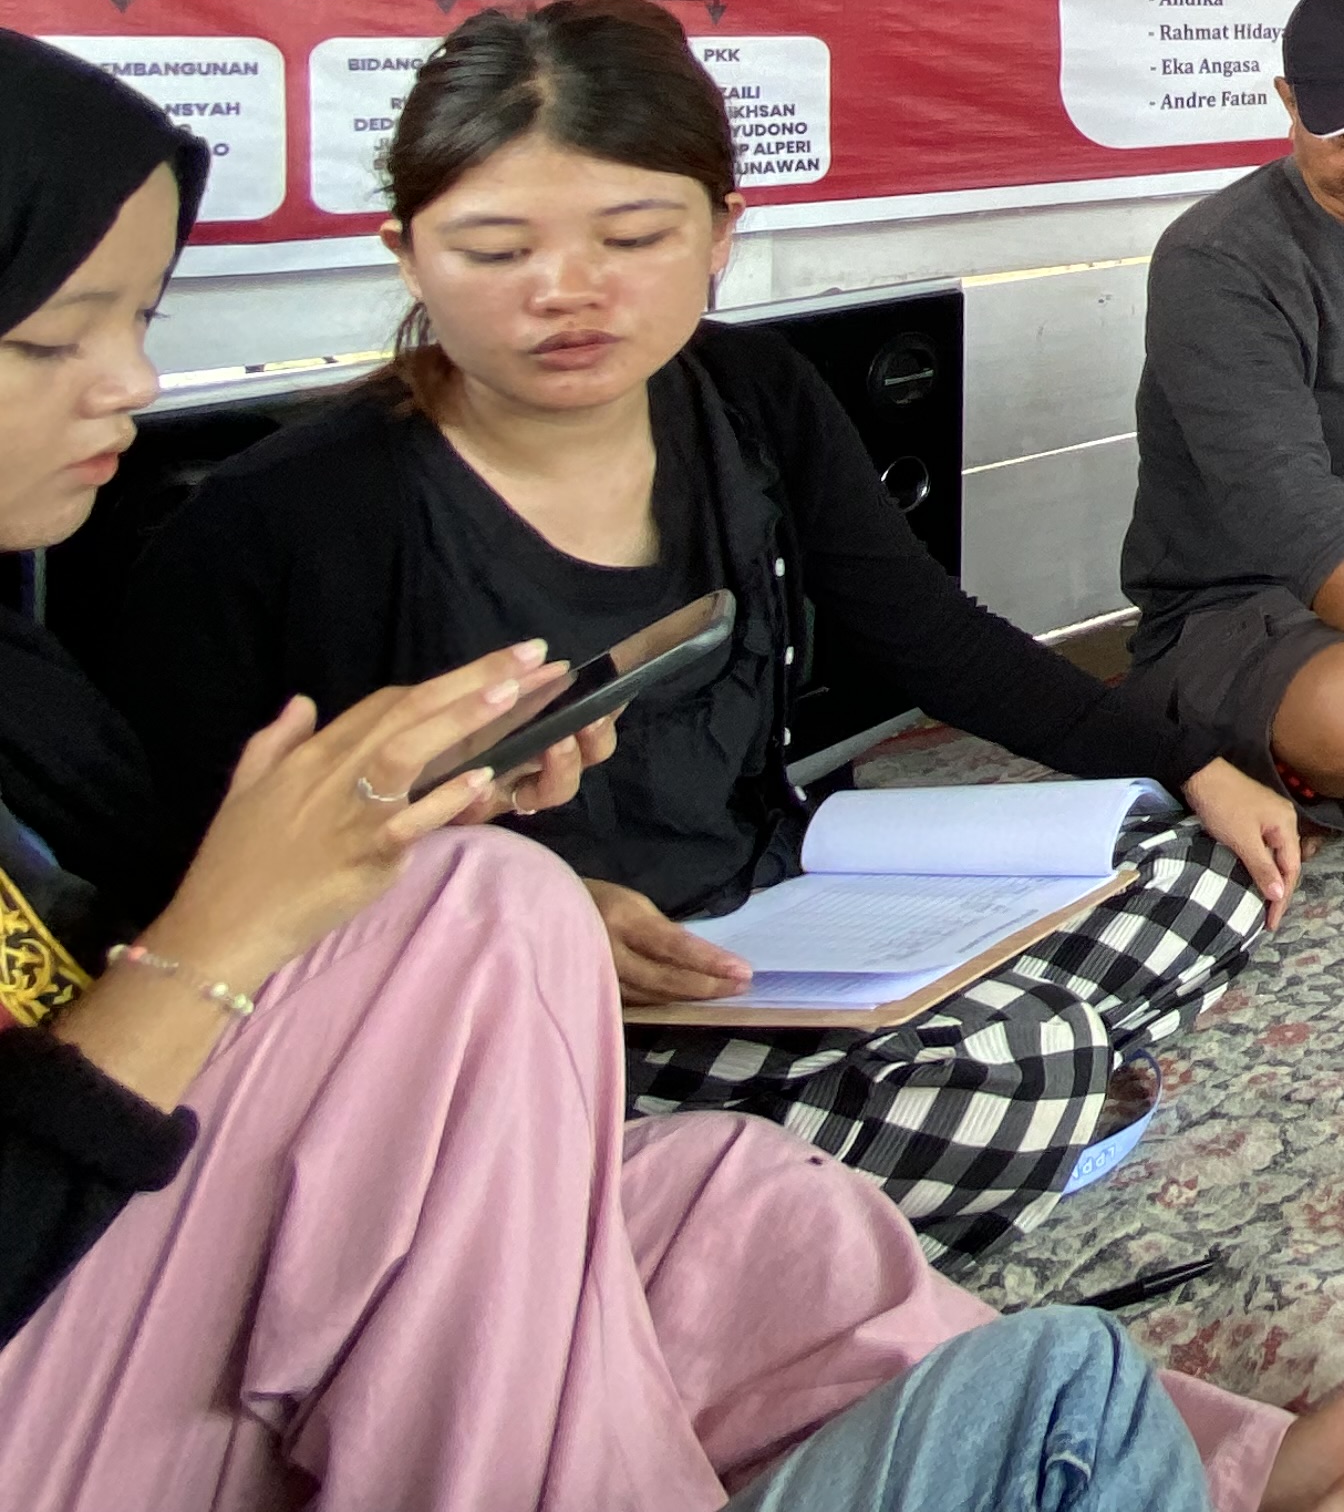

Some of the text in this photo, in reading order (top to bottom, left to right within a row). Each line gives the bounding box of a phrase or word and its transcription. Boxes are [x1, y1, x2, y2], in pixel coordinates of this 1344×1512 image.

[703, 48, 740, 62] PKK
[1161, 58, 1260, 77] Eka Angasa
[1160, 90, 1267, 110] Andre Fatan
